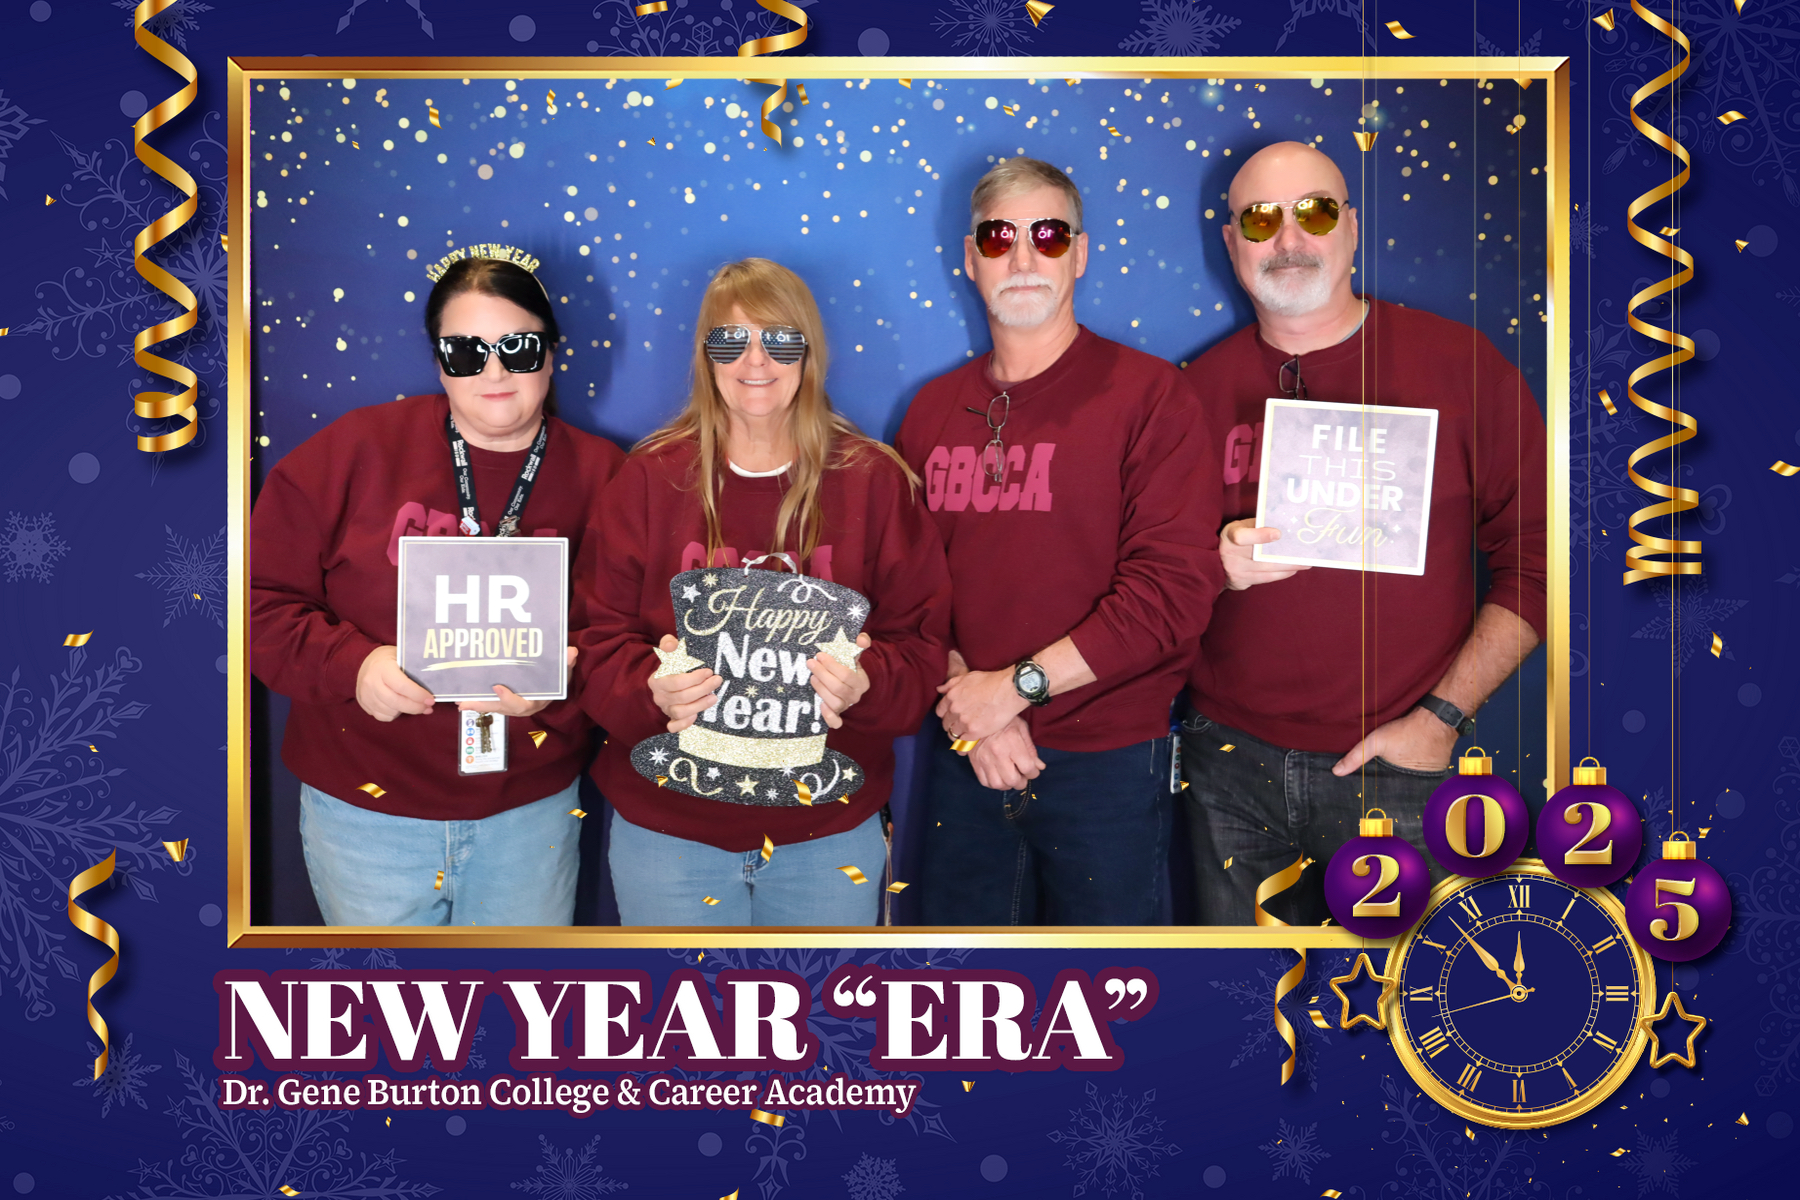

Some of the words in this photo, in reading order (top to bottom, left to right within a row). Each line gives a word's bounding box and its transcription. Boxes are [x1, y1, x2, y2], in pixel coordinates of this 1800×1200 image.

[426, 248, 465, 283] HAPPY
[469, 243, 501, 259] NEW
[505, 245, 540, 273] YEAR
[457, 439, 468, 467] Rockwall
[1312, 424, 1387, 454] FILE
[521, 453, 537, 480] Rockwall
[924, 443, 1056, 512] GBCCA
[1299, 455, 1396, 481] THIS
[1287, 477, 1404, 511] UNDER
[1297, 507, 1388, 547] Fun
[435, 575, 532, 624] HR
[684, 585, 833, 645] Happy
[423, 628, 543, 659] APPROVED
[714, 631, 818, 686] New
